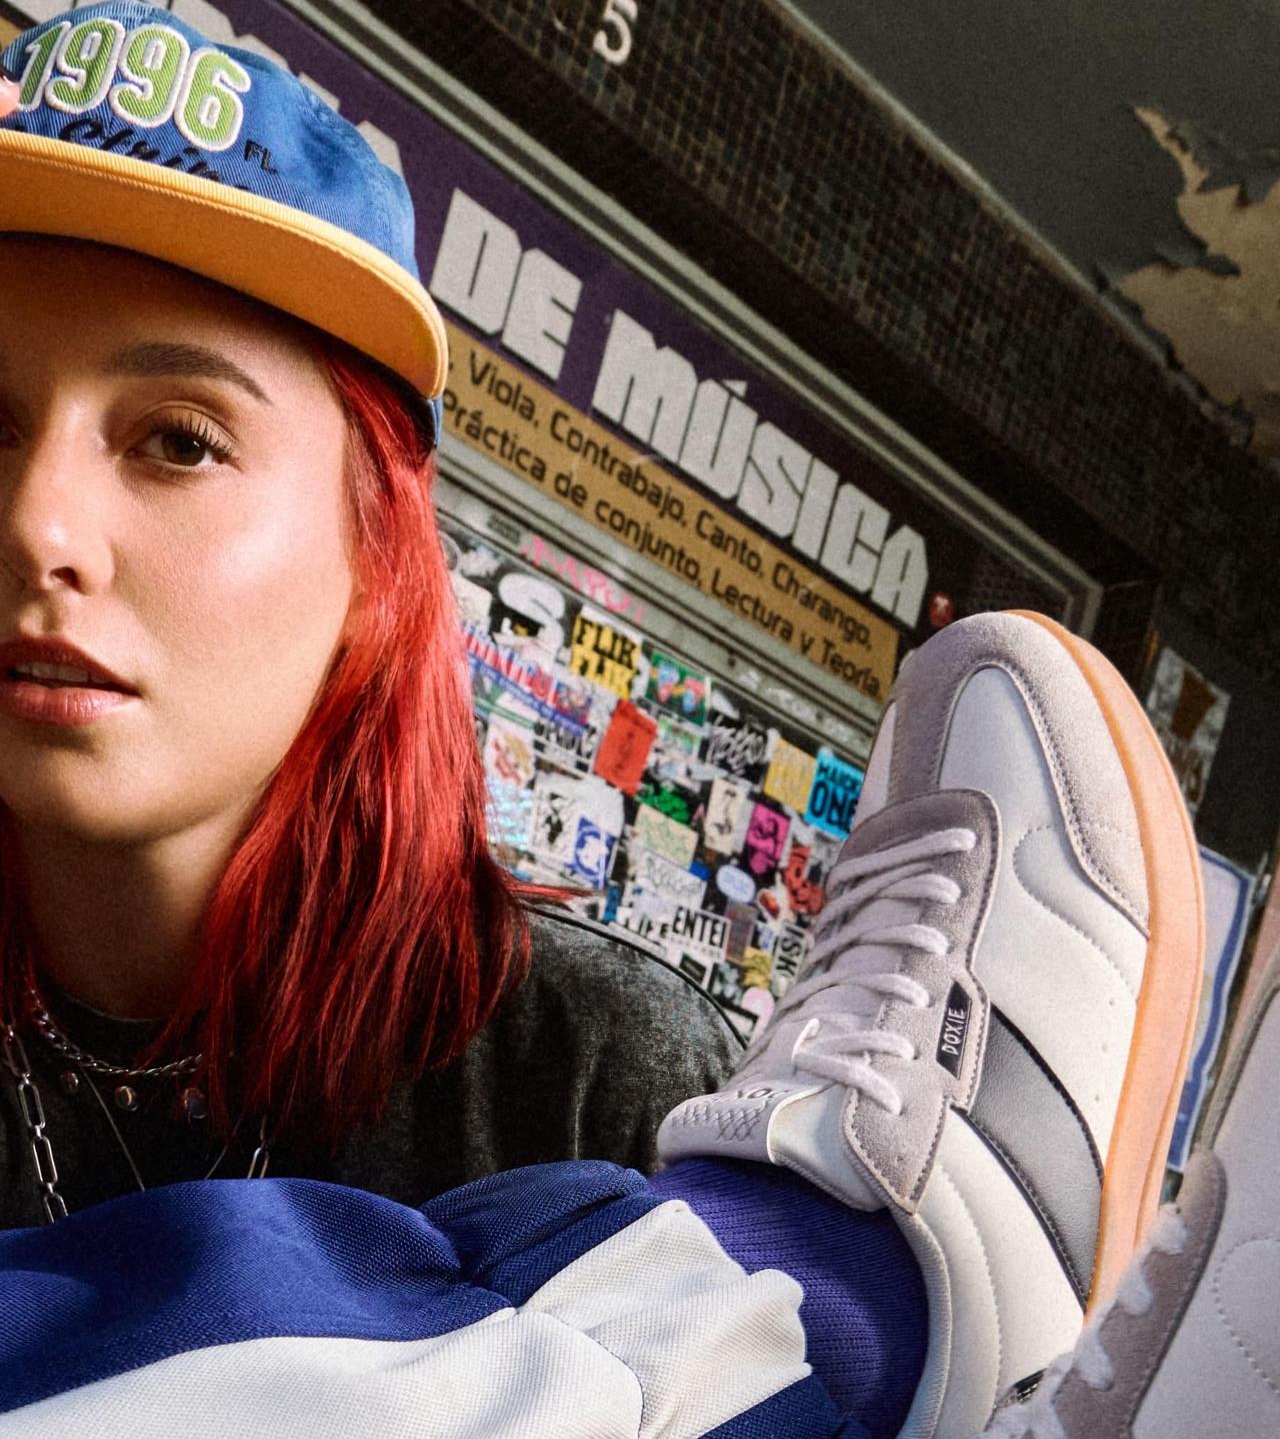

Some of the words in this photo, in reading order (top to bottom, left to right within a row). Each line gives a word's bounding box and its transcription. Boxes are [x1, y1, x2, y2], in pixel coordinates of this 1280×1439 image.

[19, 17, 252, 151] 1996
[429, 187, 582, 380] DE
[592, 309, 928, 628] MÚSICA
[550, 411, 687, 527] Contrabajo,
[695, 509, 764, 578] Canto,
[772, 562, 872, 650] Charango,
[553, 470, 589, 508] de
[594, 498, 703, 589] conjunto,
[711, 567, 795, 642] Lectura
[575, 616, 637, 671] FLIK
[941, 1007, 966, 1056] DOXIE
